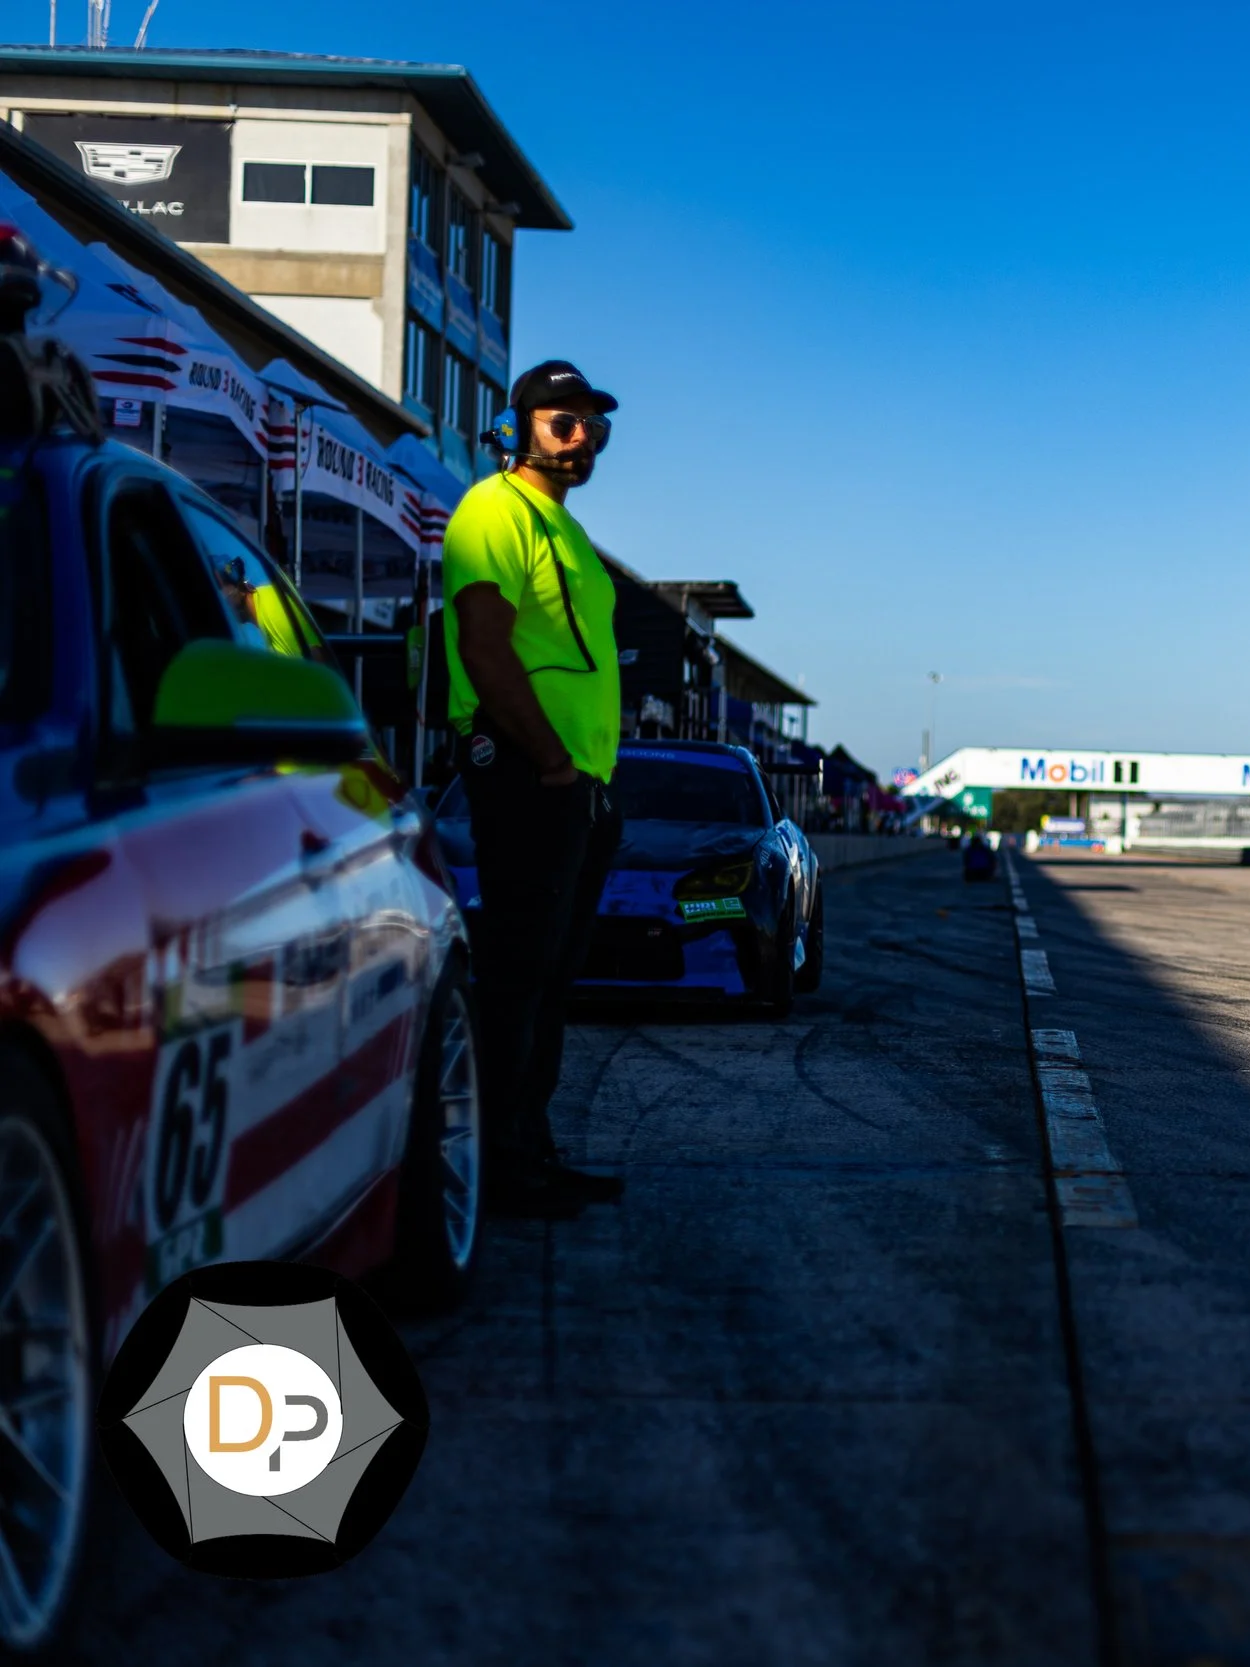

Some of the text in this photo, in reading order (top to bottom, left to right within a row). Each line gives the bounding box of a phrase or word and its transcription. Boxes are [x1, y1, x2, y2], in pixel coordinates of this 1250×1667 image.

[117, 200, 184, 215] LLAC
[189, 362, 256, 422] ROUND 3 RACING
[317, 433, 394, 506] ROUND 3 RACING
[1021, 758, 1104, 783] Mobil
[154, 1031, 233, 1232] 65
